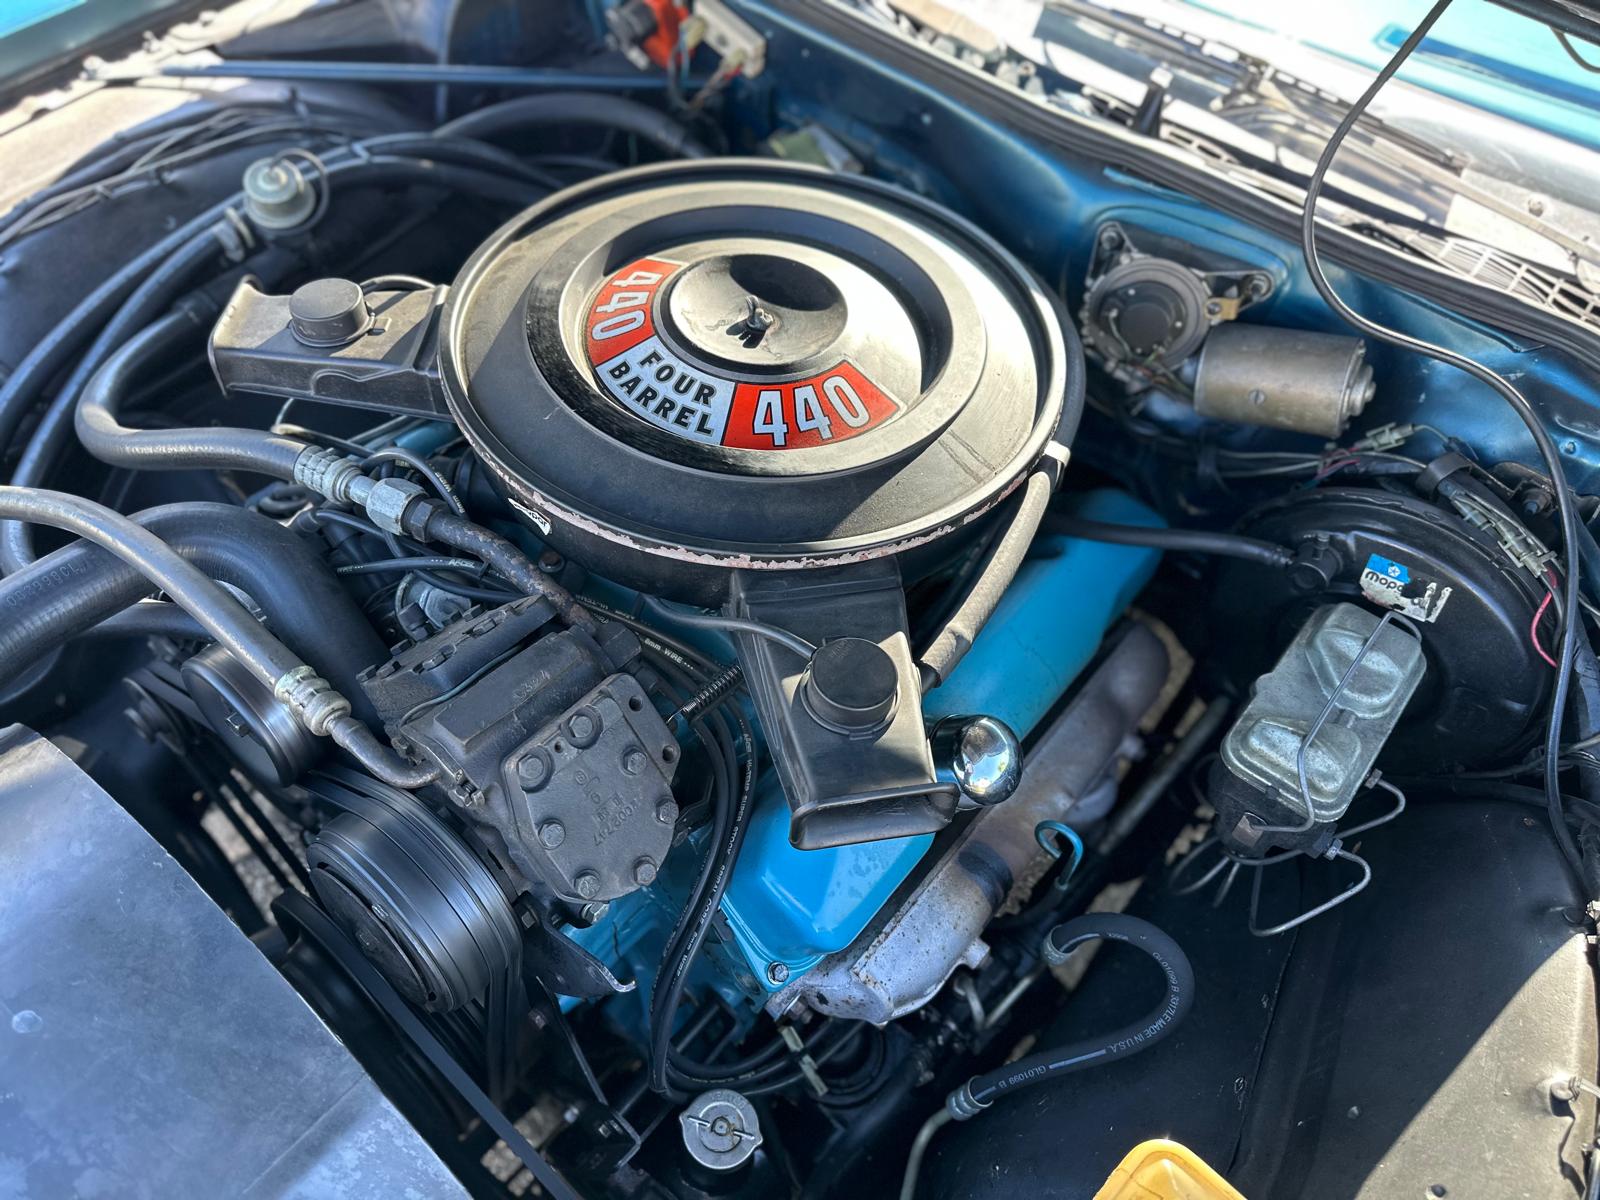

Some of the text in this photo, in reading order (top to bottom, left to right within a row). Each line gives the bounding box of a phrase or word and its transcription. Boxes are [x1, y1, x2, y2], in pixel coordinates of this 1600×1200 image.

[592, 271, 663, 341] 440
[638, 351, 717, 407] FOUR
[608, 361, 715, 436] BARREL
[753, 376, 870, 446] 440
[664, 647, 684, 664] WIRE
[1133, 1033, 1145, 1044] IN
[1144, 1017, 1166, 1038] MADE
[997, 1079, 1008, 1089] B
